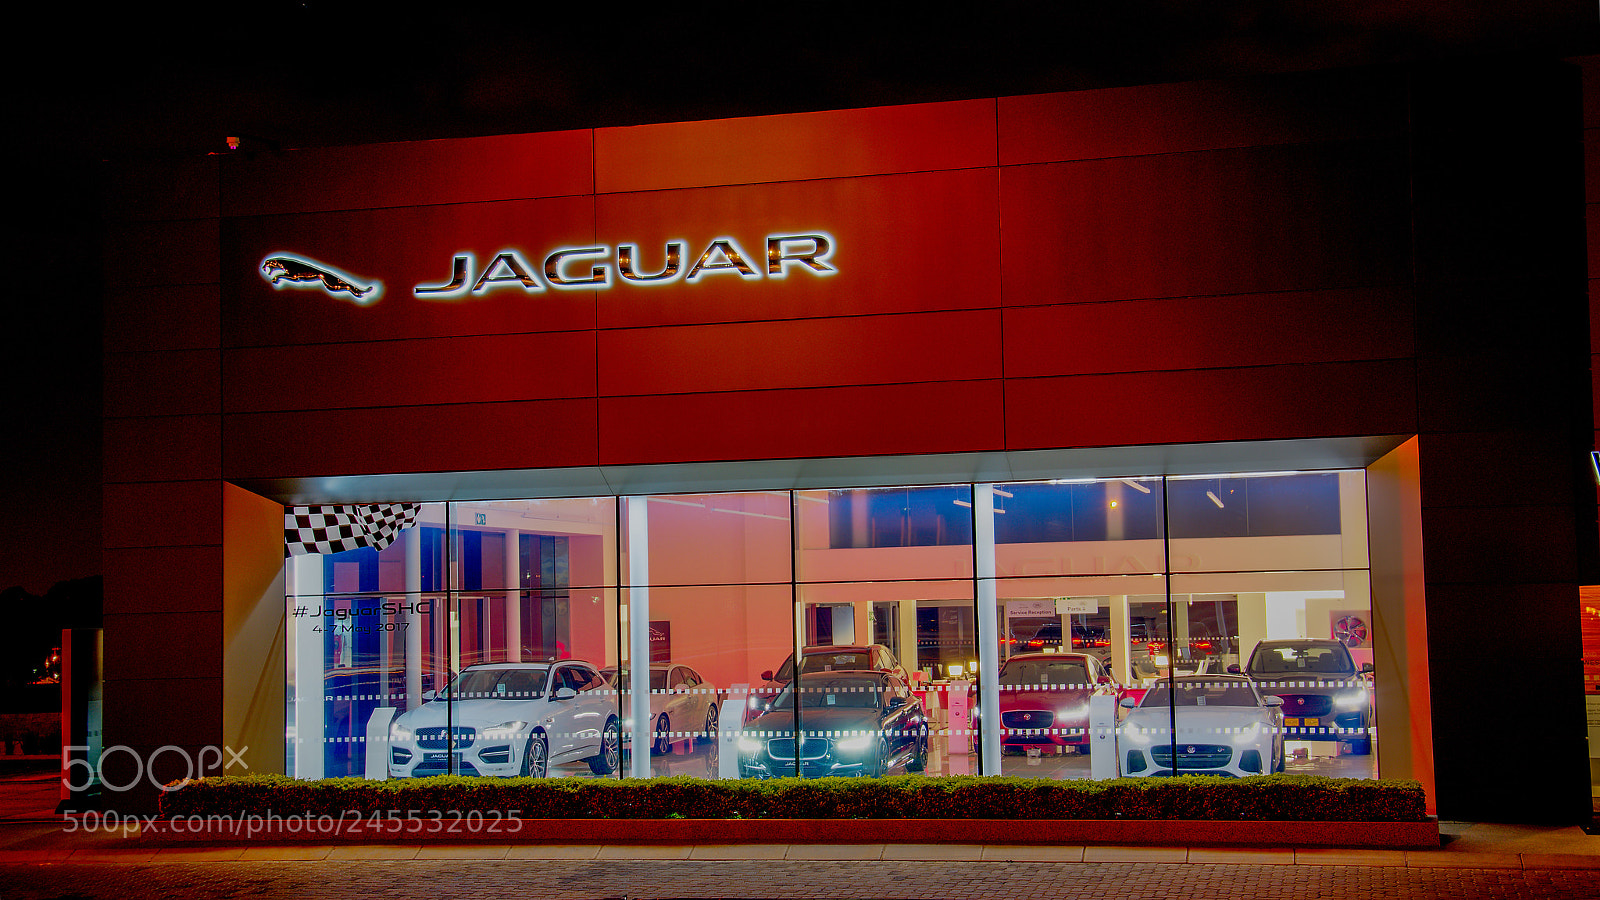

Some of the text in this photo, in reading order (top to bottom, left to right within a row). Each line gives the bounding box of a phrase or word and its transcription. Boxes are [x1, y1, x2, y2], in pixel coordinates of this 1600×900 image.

[413, 232, 836, 295] JAGUAR
[292, 602, 430, 620] #JaguarSHC
[312, 622, 410, 634] 4-7 May 2017
